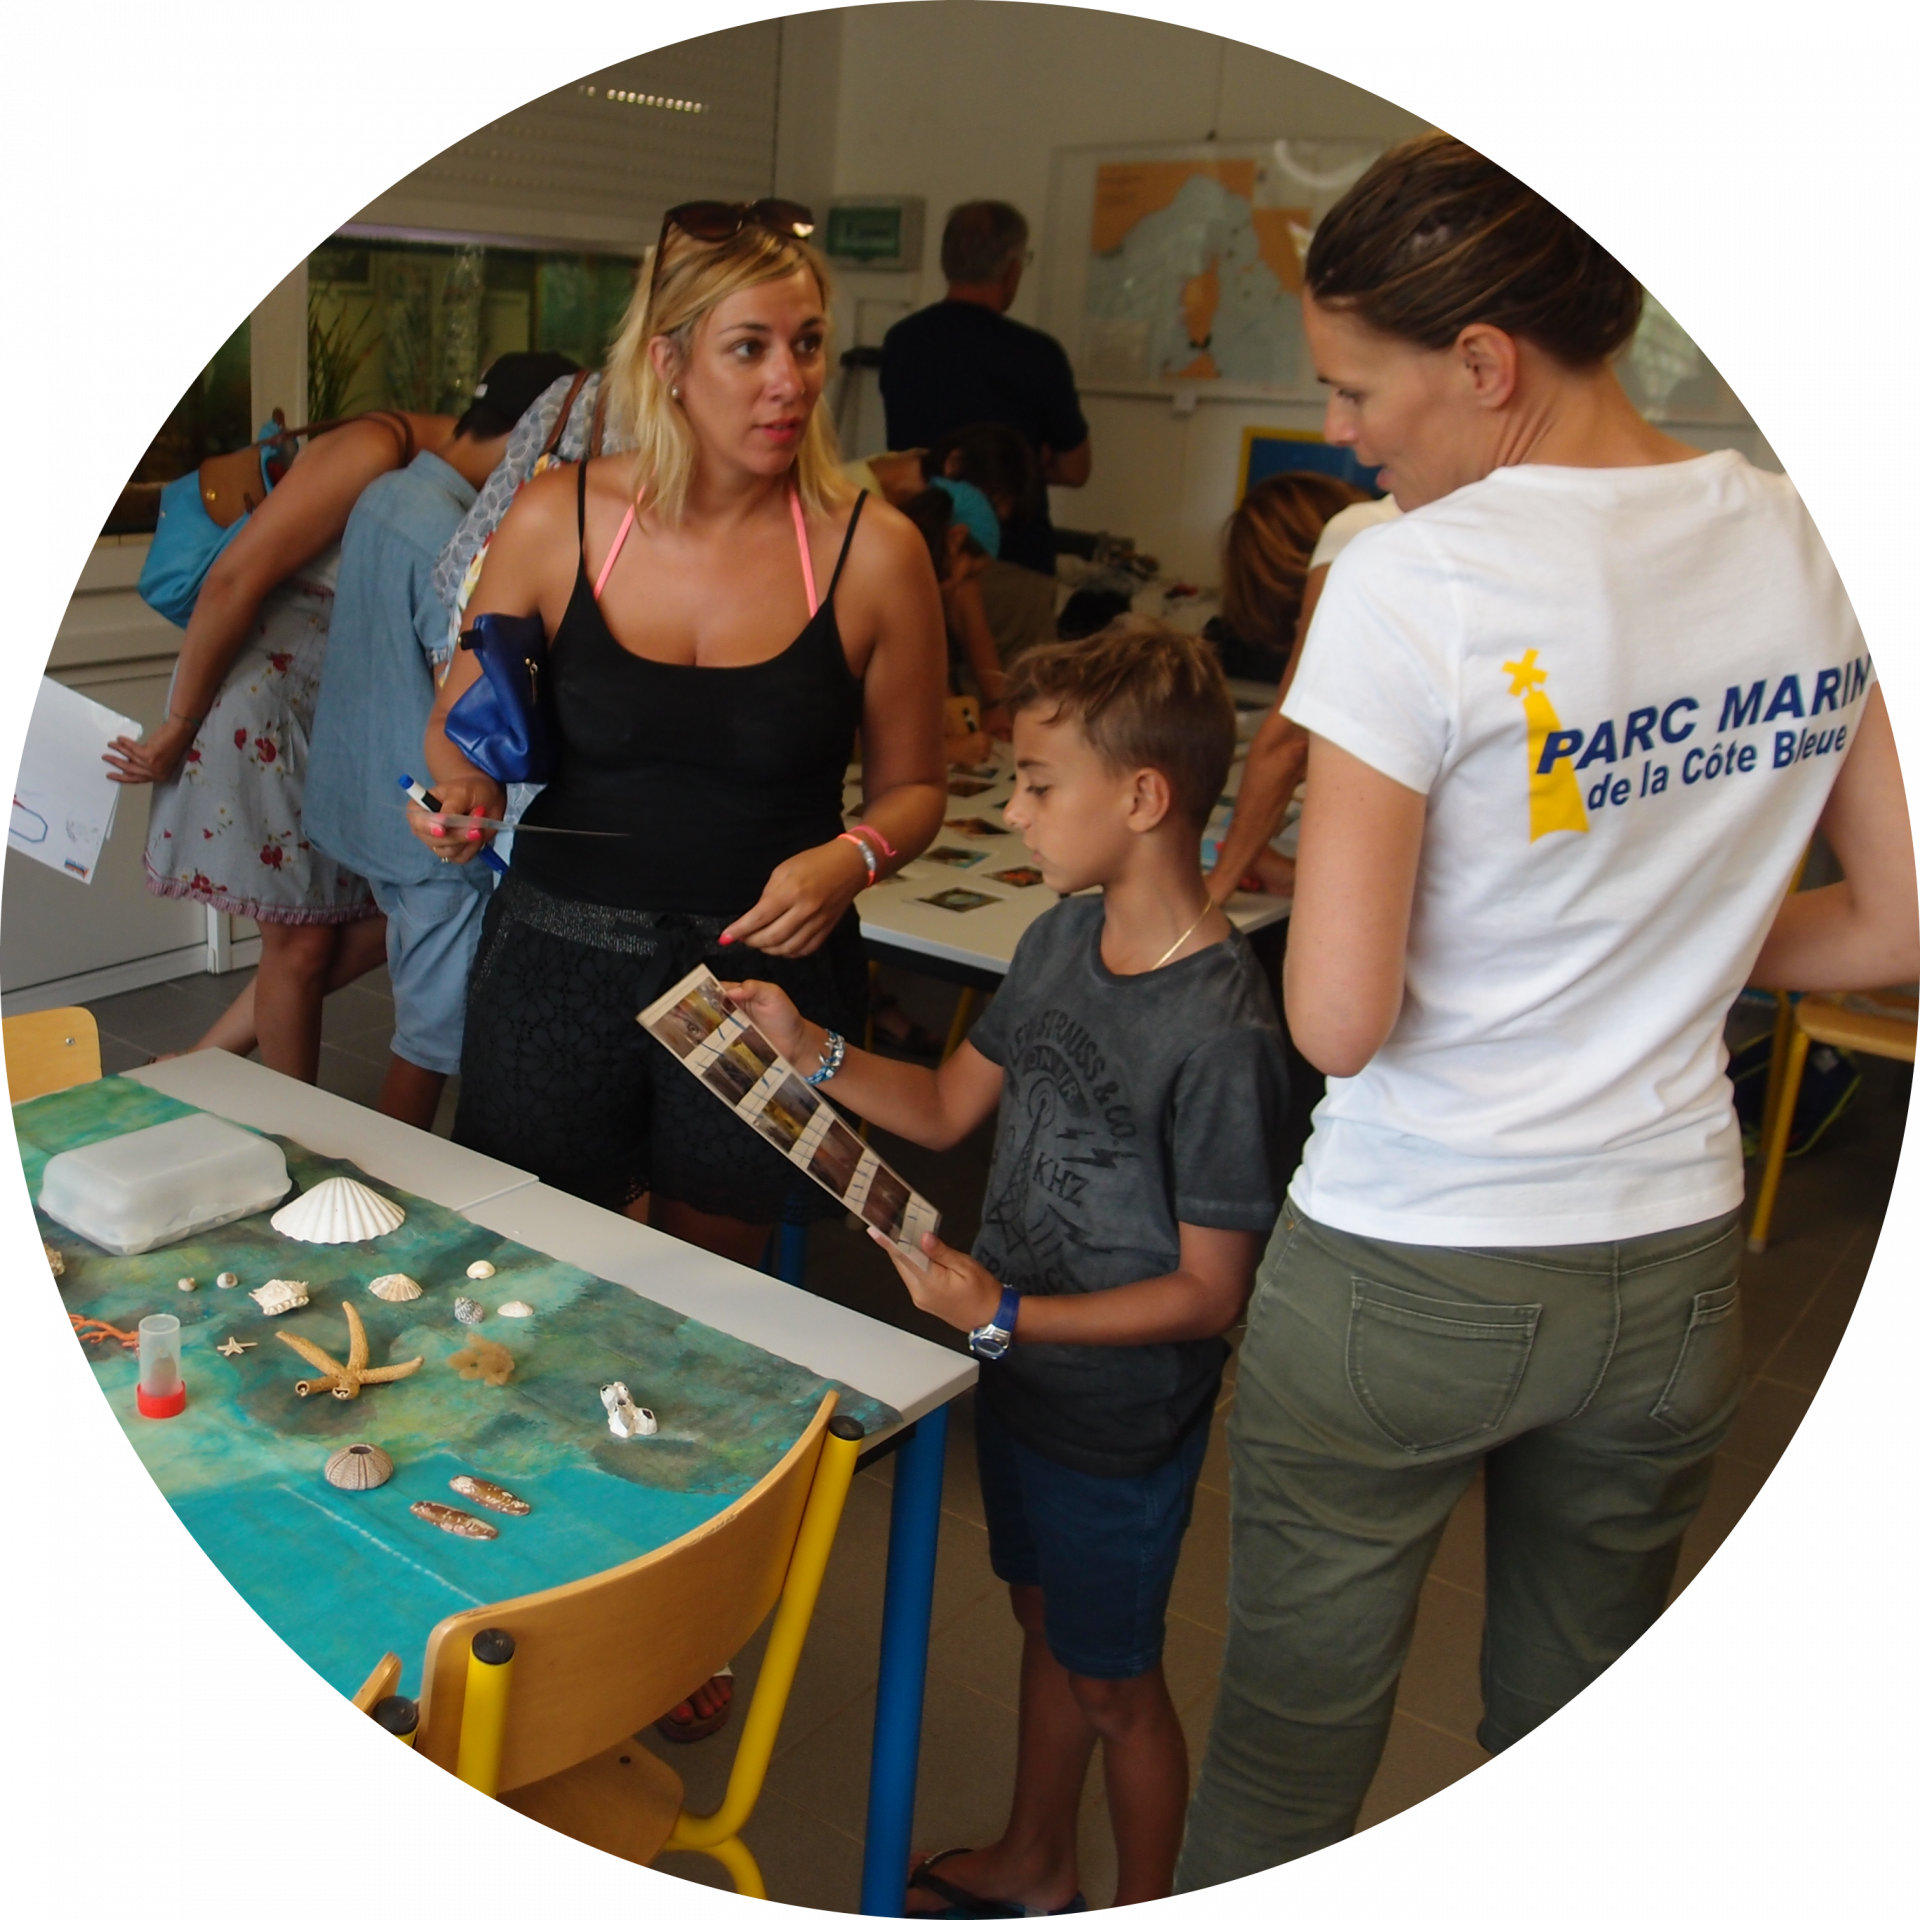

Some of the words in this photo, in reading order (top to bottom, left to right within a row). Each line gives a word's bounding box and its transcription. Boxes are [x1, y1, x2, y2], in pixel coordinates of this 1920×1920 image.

[1535, 697, 1700, 775] PARC
[1717, 651, 1872, 733] MARIN
[1588, 772, 1632, 811] de
[1640, 760, 1670, 798] la
[1682, 742, 1758, 785] Côte
[1771, 724, 1848, 769] Bleue
